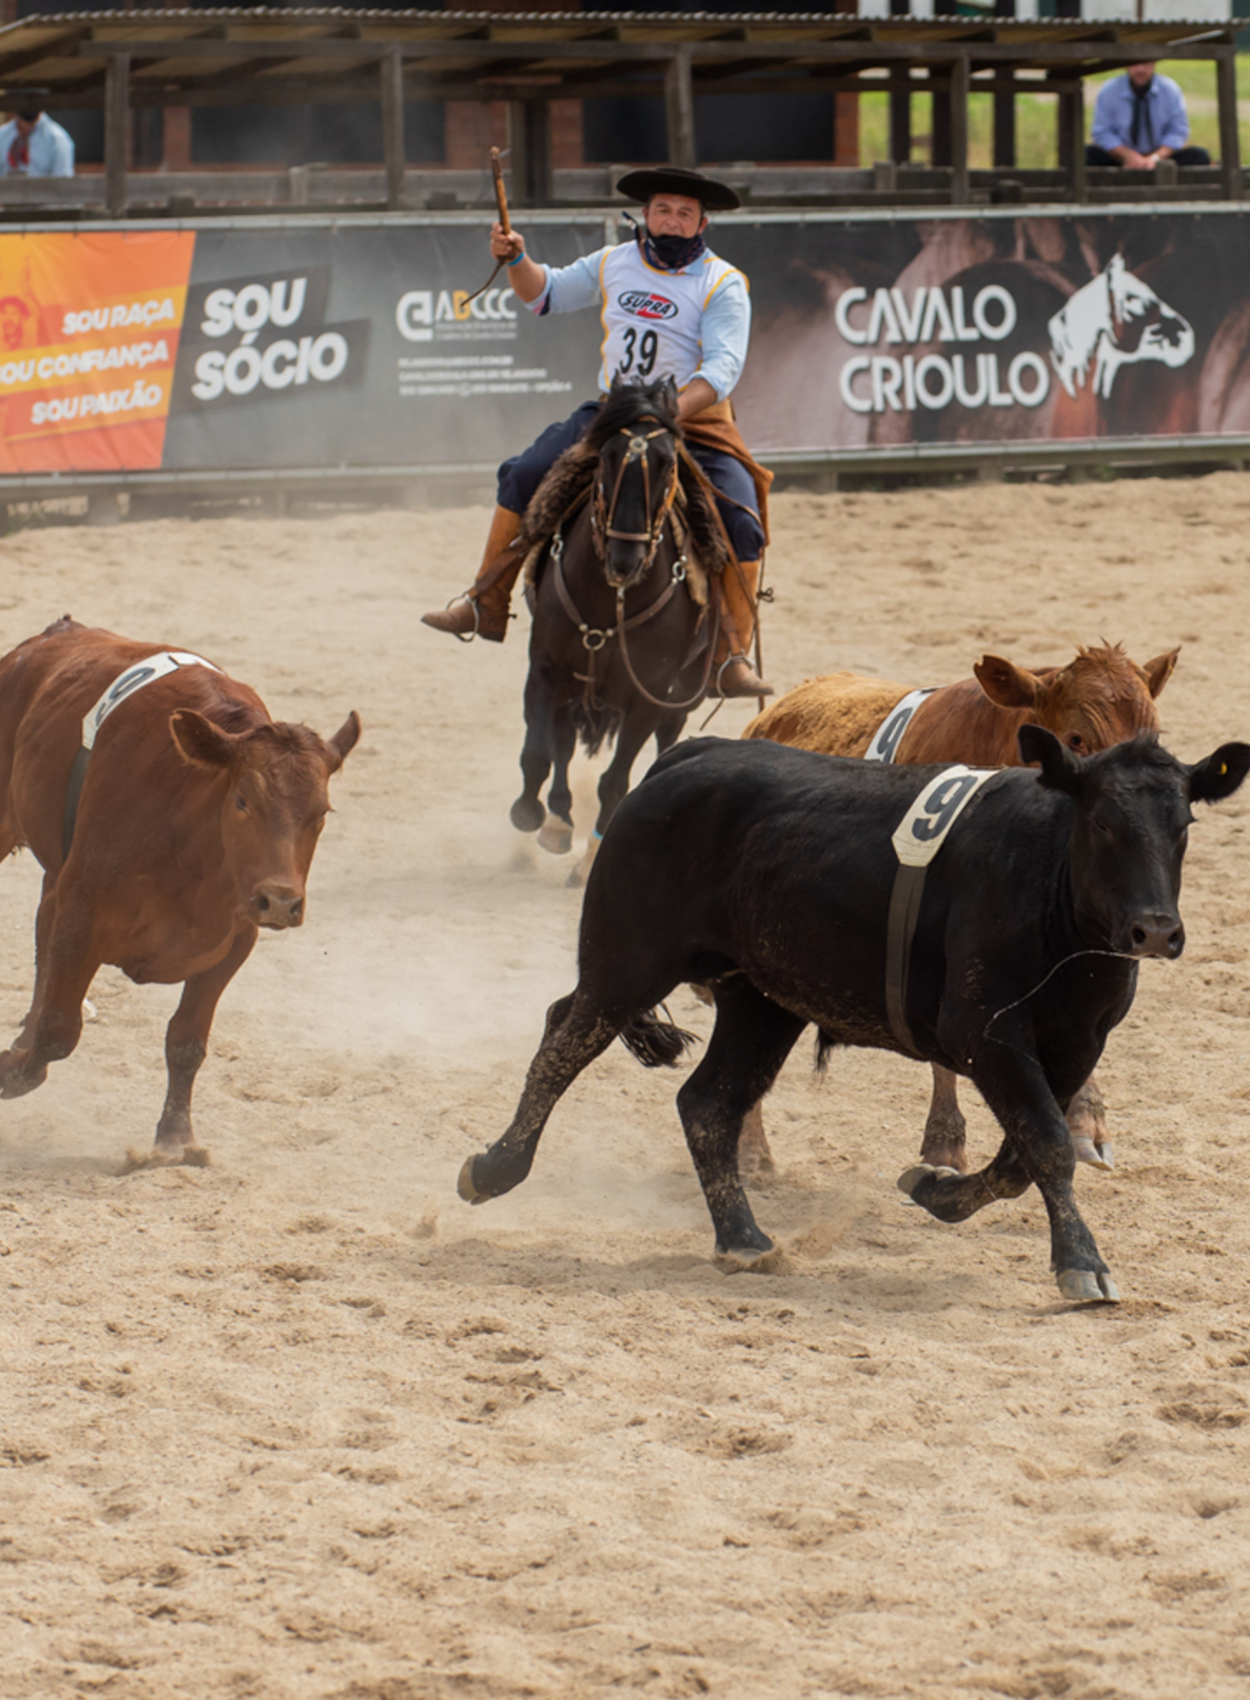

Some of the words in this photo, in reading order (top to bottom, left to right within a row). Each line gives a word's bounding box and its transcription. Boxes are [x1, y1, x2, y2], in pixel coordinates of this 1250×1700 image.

[62, 307, 110, 335] SOU
[110, 298, 174, 328] RAÇA
[200, 277, 307, 338] SOU
[435, 288, 517, 321] ABCCC
[621, 294, 672, 316] SUPRA
[835, 284, 1017, 344] CAVALO
[0, 359, 36, 386] OU
[37, 339, 169, 380] CONFIANÇA
[191, 331, 348, 401] SÓCIO
[620, 327, 658, 376] 39
[31, 396, 79, 425] SOU
[80, 380, 162, 417] PAIXÃO
[839, 351, 1049, 413] CRIOULO
[911, 774, 979, 842] 9
